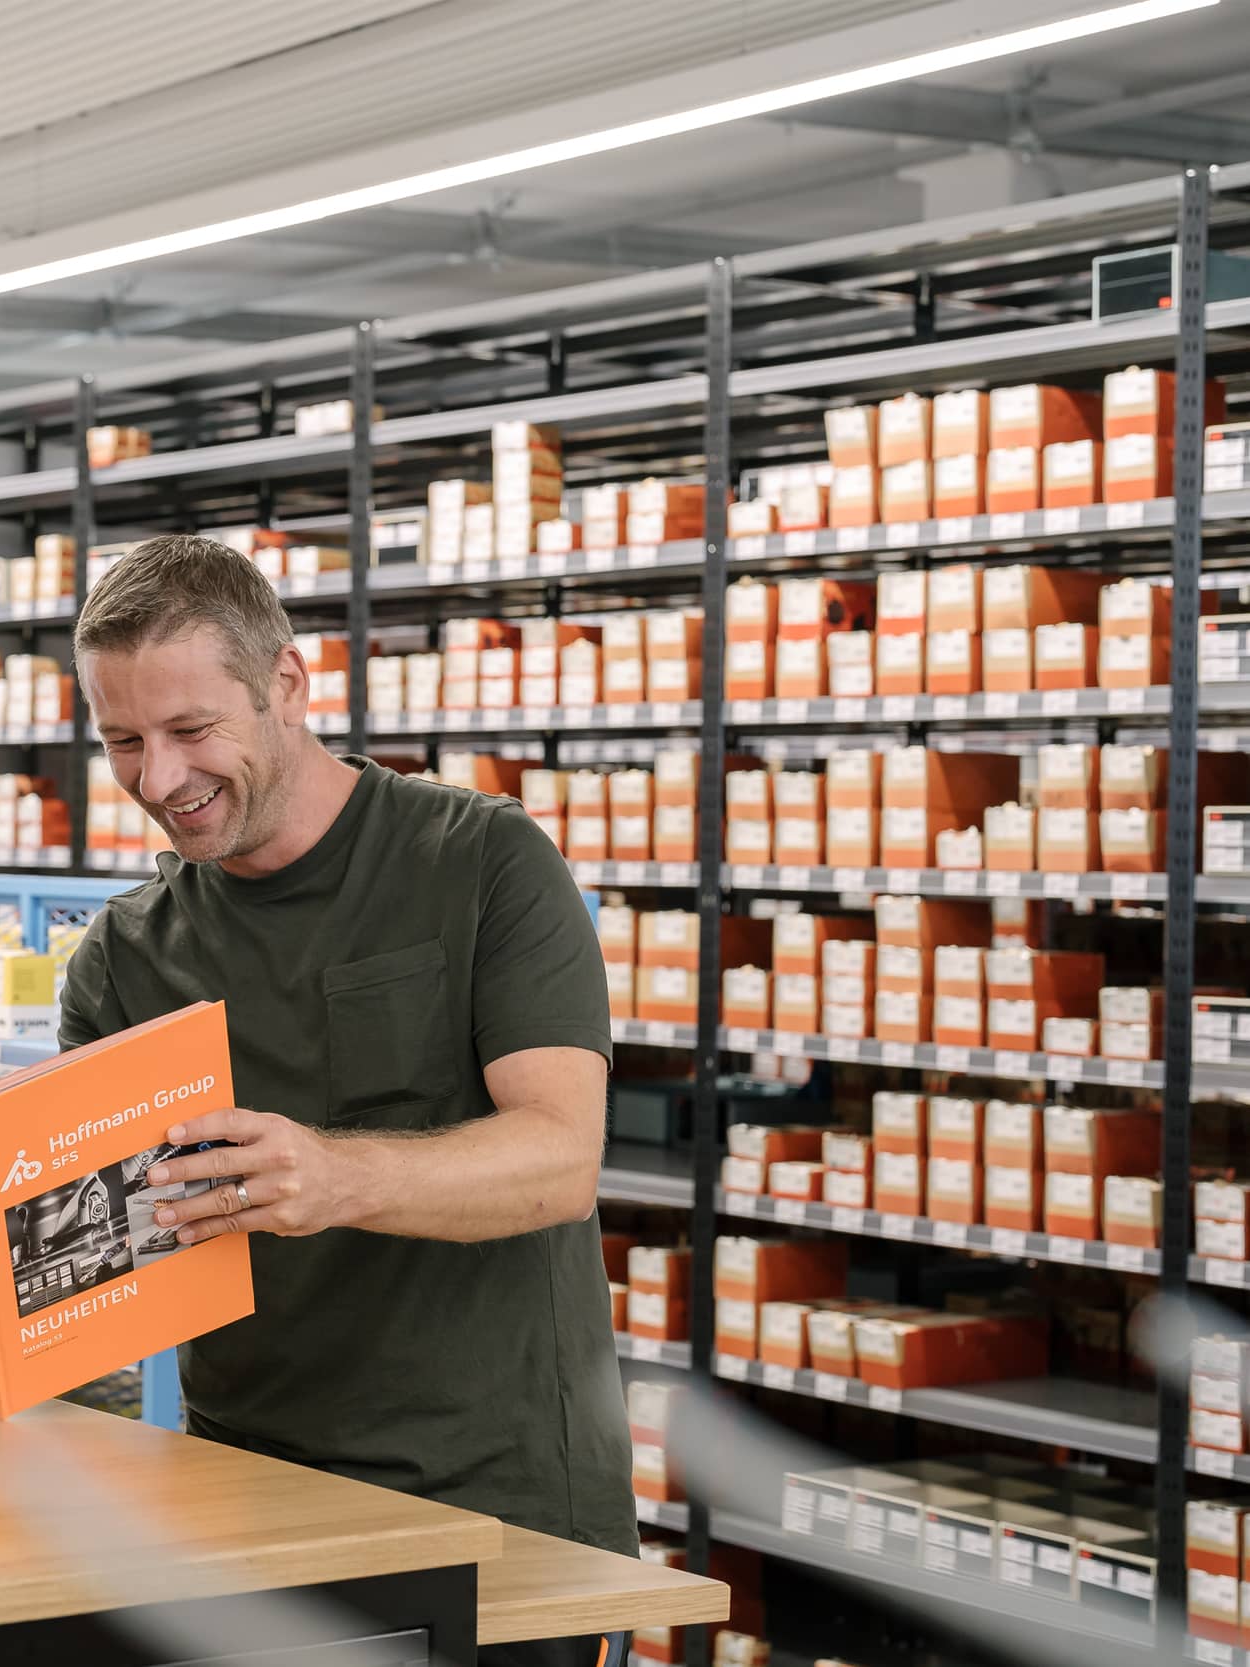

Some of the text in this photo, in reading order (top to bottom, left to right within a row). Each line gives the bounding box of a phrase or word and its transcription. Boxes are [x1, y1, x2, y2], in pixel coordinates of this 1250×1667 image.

[49, 1075, 215, 1152] Hoffmann Group
[52, 1151, 79, 1170] SFS
[20, 1280, 138, 1343] NEUHEITEN
[22, 1338, 52, 1356] Katalog
